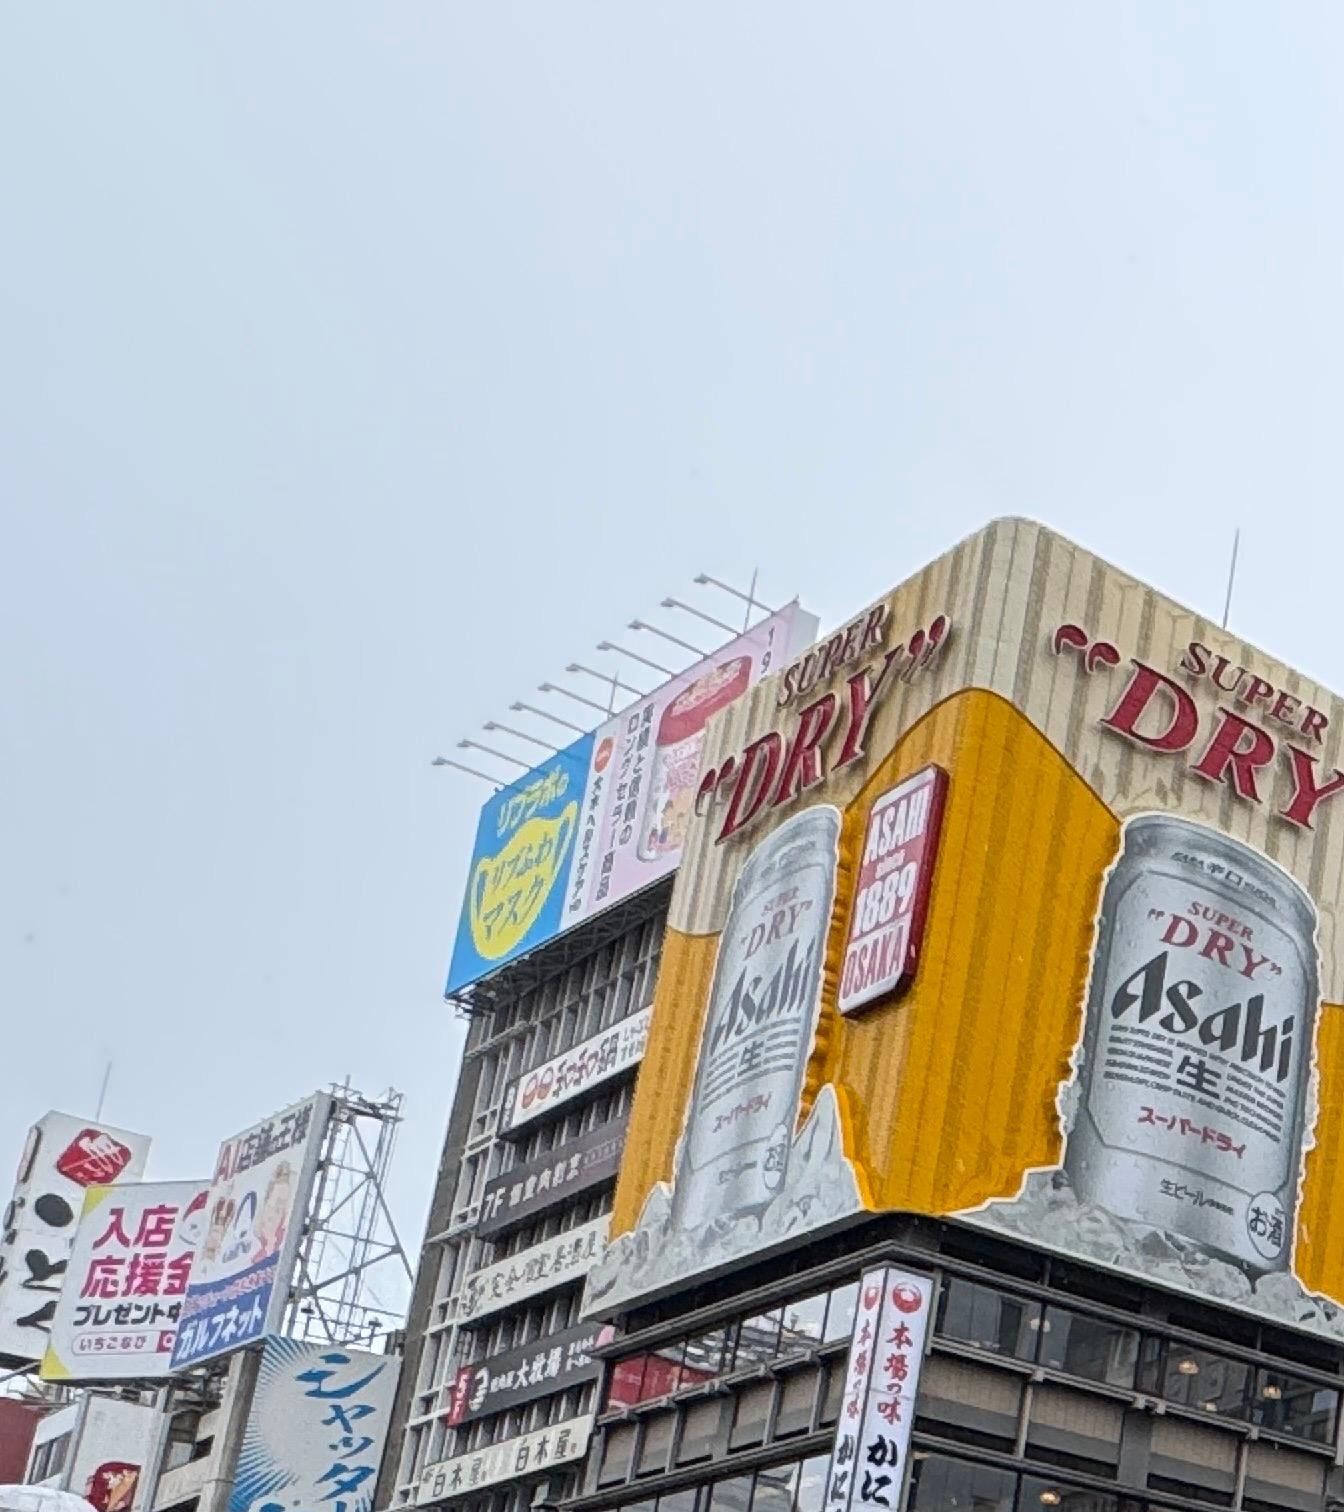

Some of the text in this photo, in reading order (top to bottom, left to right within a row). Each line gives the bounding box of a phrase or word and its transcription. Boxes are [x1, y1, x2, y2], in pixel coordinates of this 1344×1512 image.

[777, 602, 891, 707] SUPER
[1179, 641, 1330, 745] SUPER
[863, 783, 929, 864] ASAHI
[852, 861, 917, 940] 1889
[1187, 899, 1255, 943] SUPER
[711, 937, 816, 1057] Asahi
[842, 924, 906, 1000] OSAKA
[740, 1036, 764, 1072] 生
[1111, 950, 1296, 1085] Asahi
[1175, 1053, 1224, 1099] 生
[1137, 1106, 1247, 1160] スーパードライ
[92, 1204, 181, 1251] 入店
